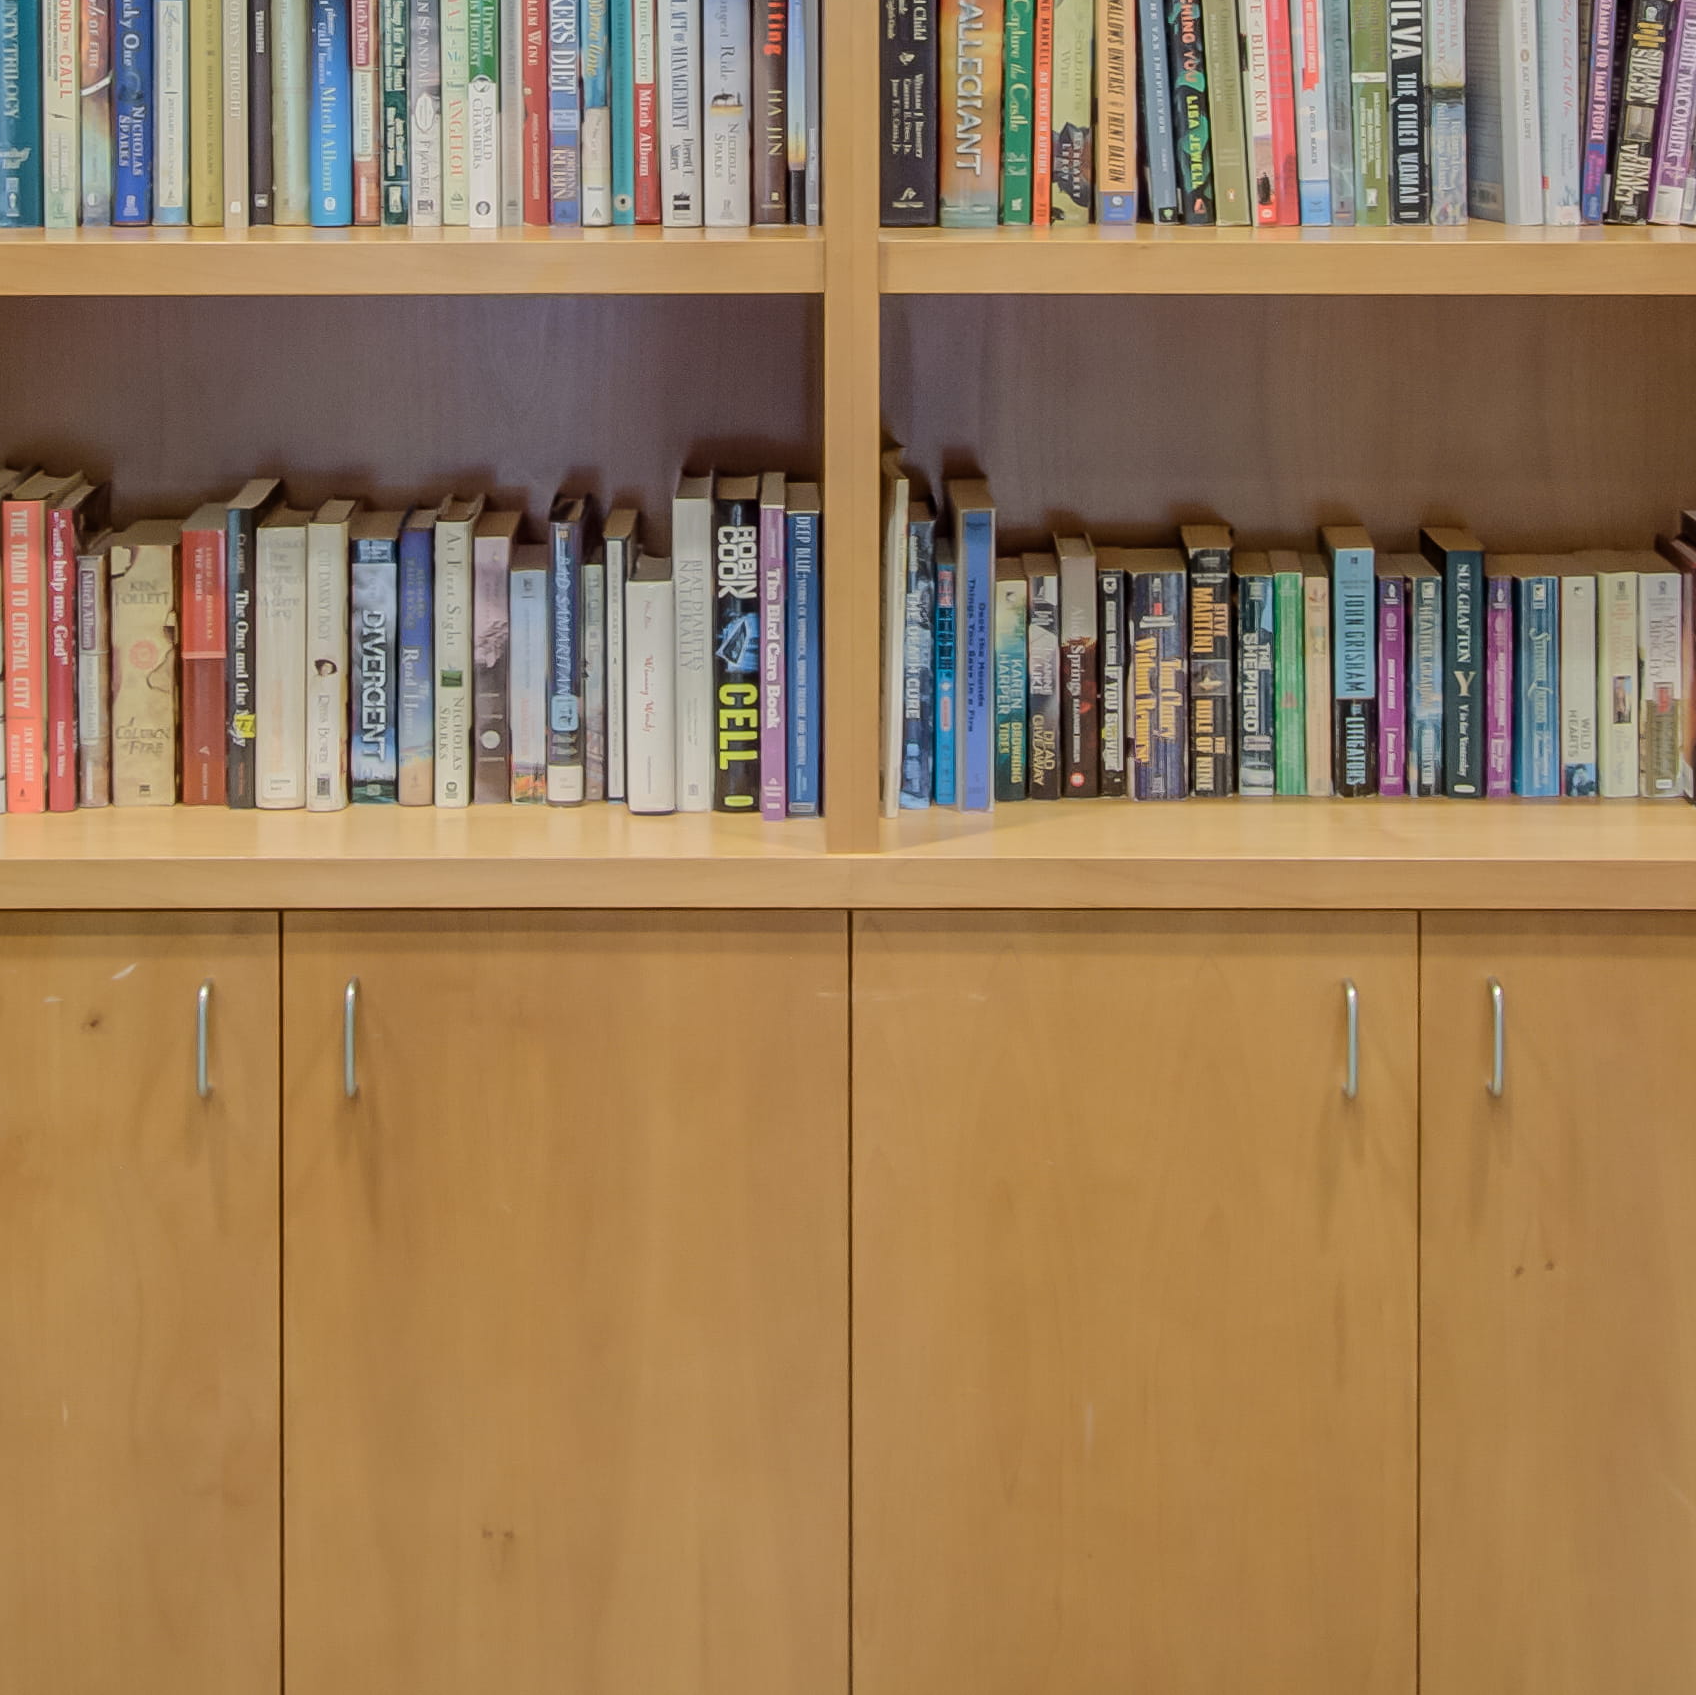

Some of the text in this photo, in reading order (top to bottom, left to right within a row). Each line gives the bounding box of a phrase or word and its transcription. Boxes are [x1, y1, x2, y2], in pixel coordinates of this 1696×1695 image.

[123, 34, 139, 66] One
[956, 2, 983, 175] ALLEGIANT
[1183, 51, 1197, 82] YOU
[1185, 95, 1203, 188] LISA JEWELL
[1396, 72, 1418, 204] THE OTHER WOMAN
[10, 510, 30, 708] THE TRAIN TO CRYSTAL CITY
[718, 526, 738, 598] COOK
[739, 526, 757, 598] ROBIN
[767, 569, 781, 728] The Bird Care Book
[1258, 643, 1271, 669] THE
[1344, 593, 1366, 692] JOHN GRISHAM
[1456, 564, 1471, 663] SUE GRAFTON
[362, 610, 385, 761] DIVERGENT
[719, 683, 758, 770] CELL
[1243, 632, 1258, 732] SHEPHERD
